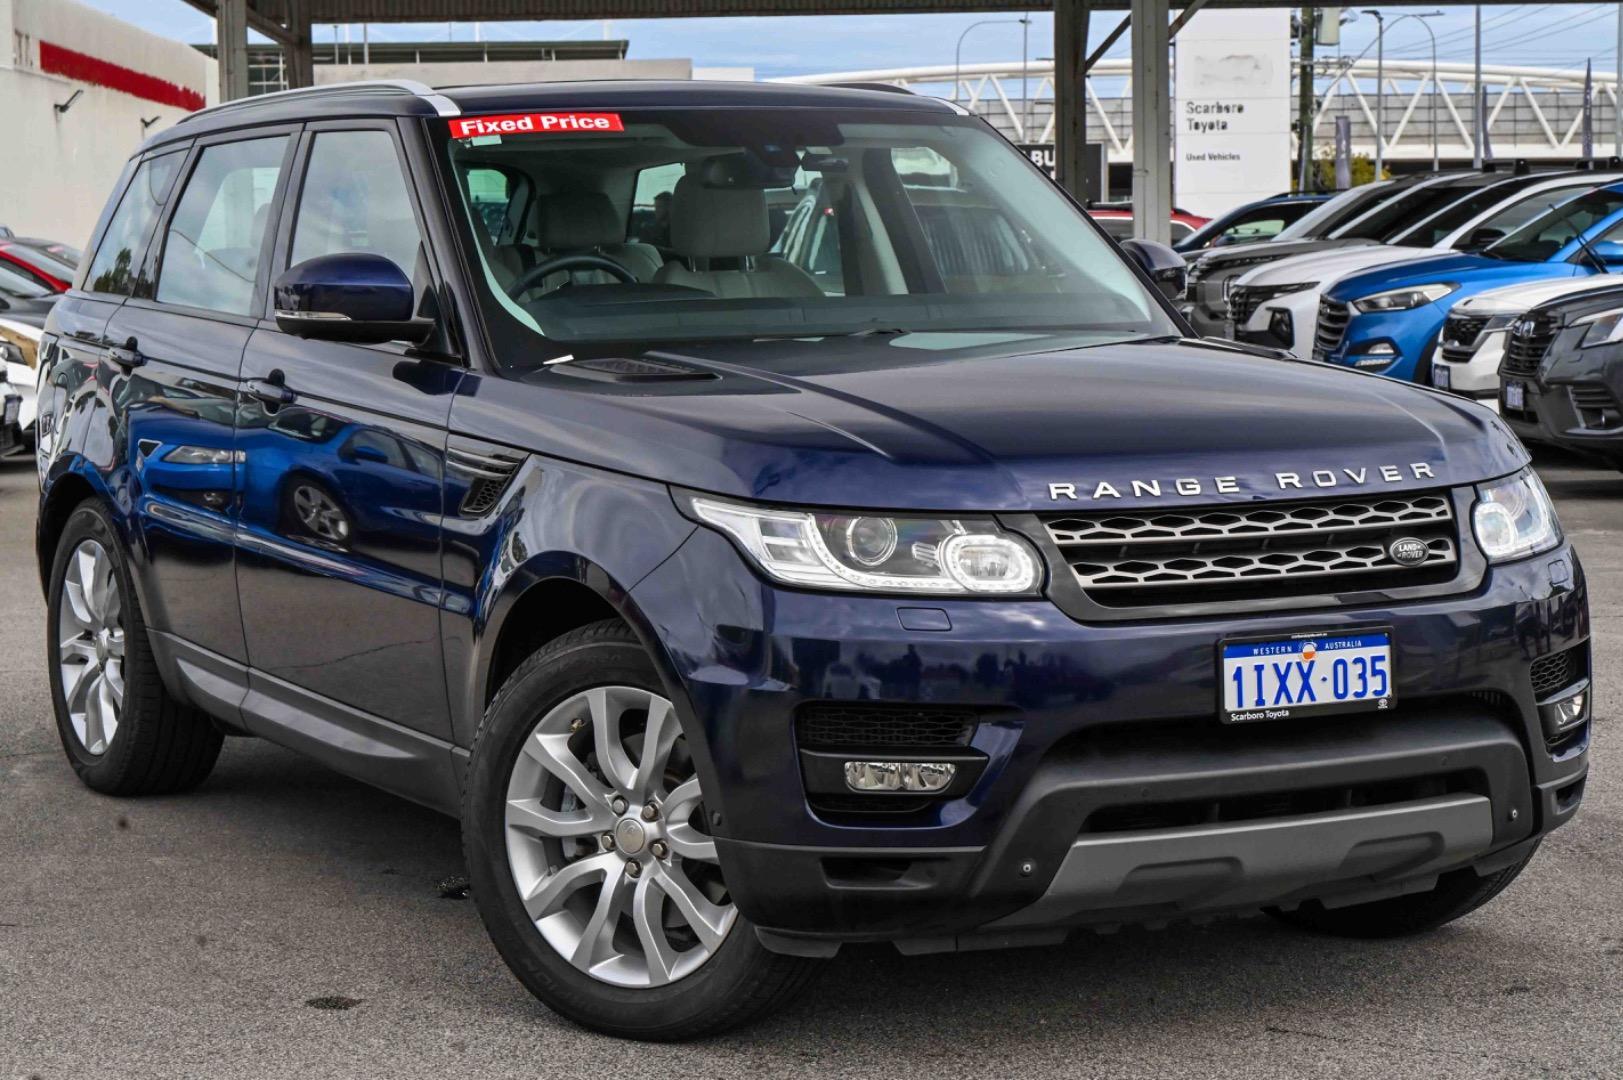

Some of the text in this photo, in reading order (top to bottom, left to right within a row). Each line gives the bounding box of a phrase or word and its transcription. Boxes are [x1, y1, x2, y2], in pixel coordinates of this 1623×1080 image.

[1186, 101, 1244, 114] Scarboro
[460, 114, 610, 136] Fixed Price
[1186, 118, 1229, 133] Toyota
[1186, 152, 1241, 161] Used Vehicles
[1048, 462, 1435, 500] RANGE ROVER
[1253, 639, 1363, 656] WESTERN AUSTRALIA
[1230, 709, 1290, 722] Scarboro Toyota
